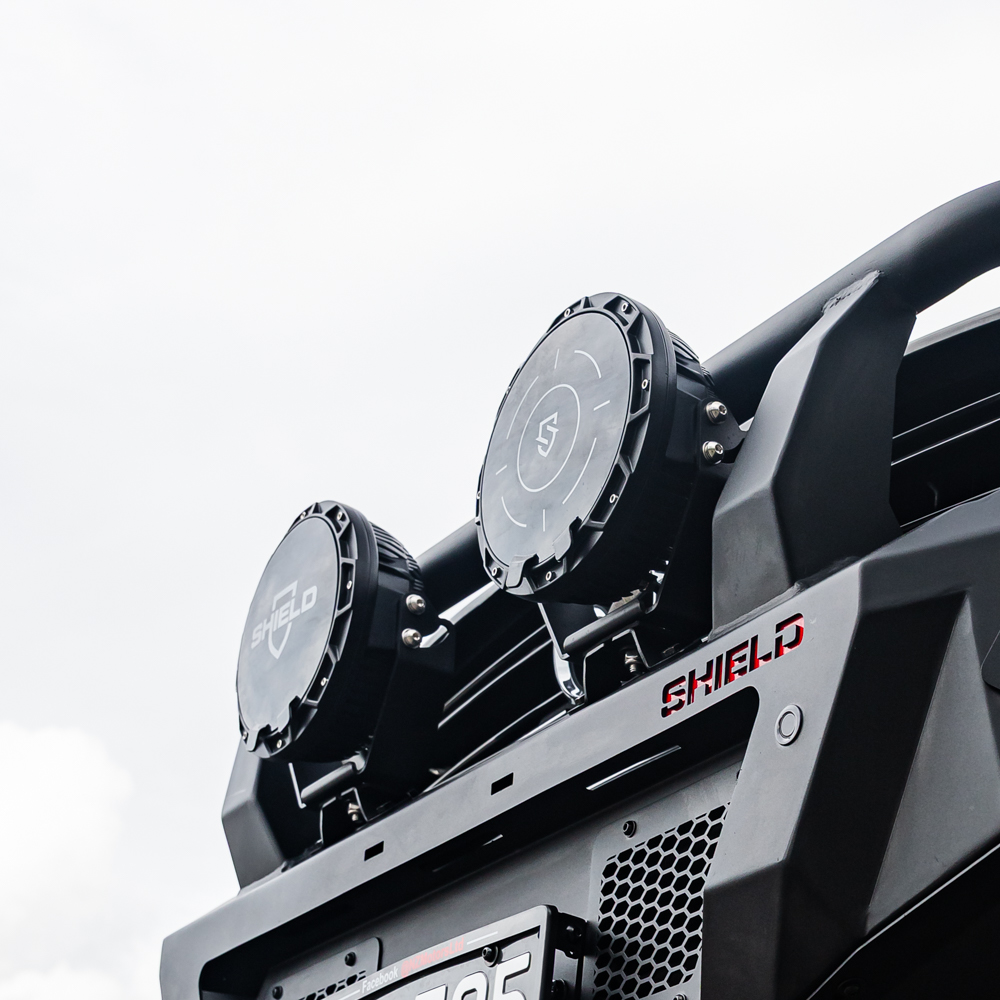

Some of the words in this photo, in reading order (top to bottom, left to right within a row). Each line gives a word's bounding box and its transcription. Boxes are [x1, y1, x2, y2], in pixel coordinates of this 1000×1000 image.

[251, 585, 318, 649] SHIELD
[661, 612, 805, 718] SHIELD
[361, 966, 399, 993] Facebook
[400, 937, 465, 978] @NZMotorsLtd
